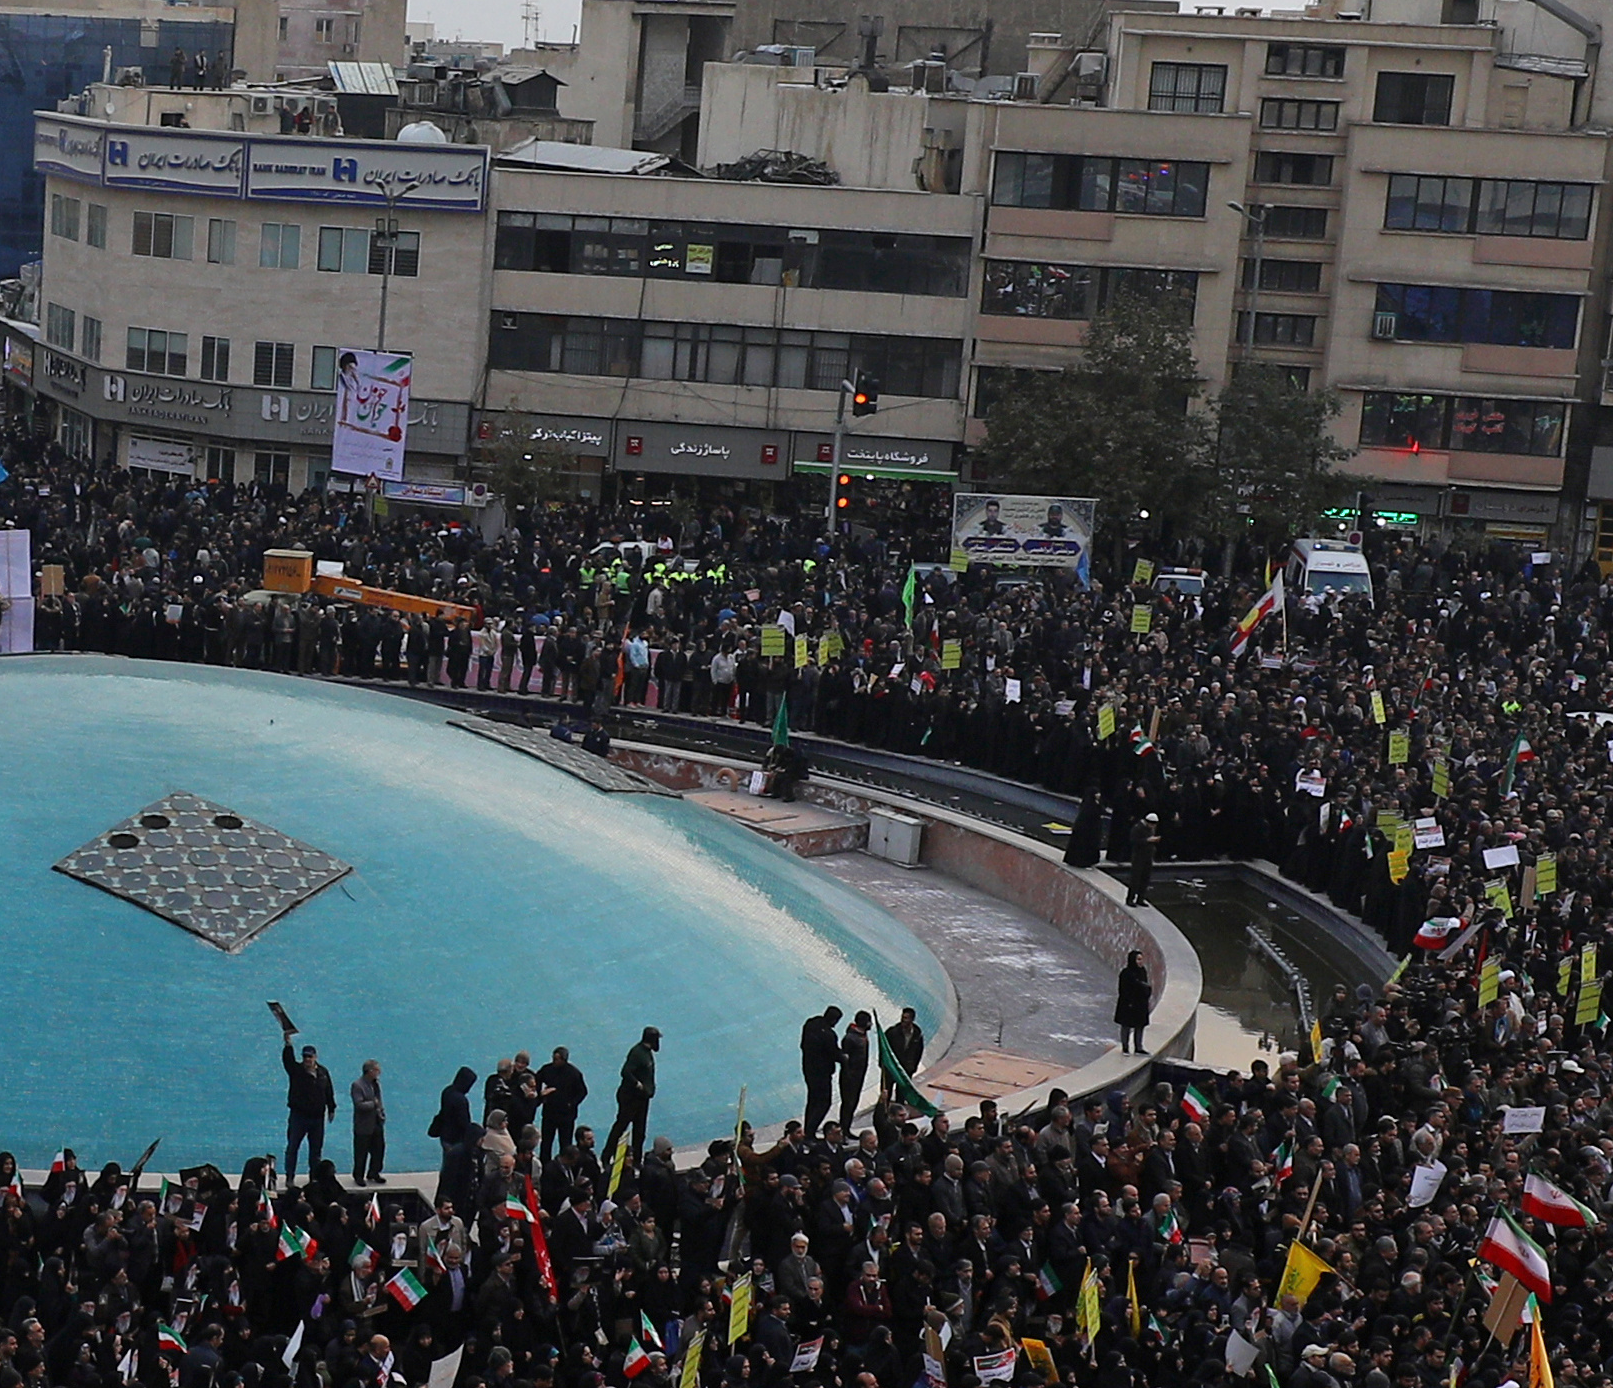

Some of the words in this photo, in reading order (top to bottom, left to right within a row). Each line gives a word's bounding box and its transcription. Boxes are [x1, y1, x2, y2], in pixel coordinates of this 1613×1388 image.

[363, 169, 396, 186] ایران
[398, 170, 445, 186] صادرات
[448, 165, 481, 192] بانک
[131, 384, 158, 405] ایران
[158, 387, 201, 405] صادرات
[203, 389, 232, 418] بانک
[577, 431, 603, 446] پیتزا
[670, 442, 704, 457] زندگی
[703, 444, 731, 460] پاساژ
[846, 448, 885, 466] پایتخت
[885, 451, 929, 466] فروشگاه
